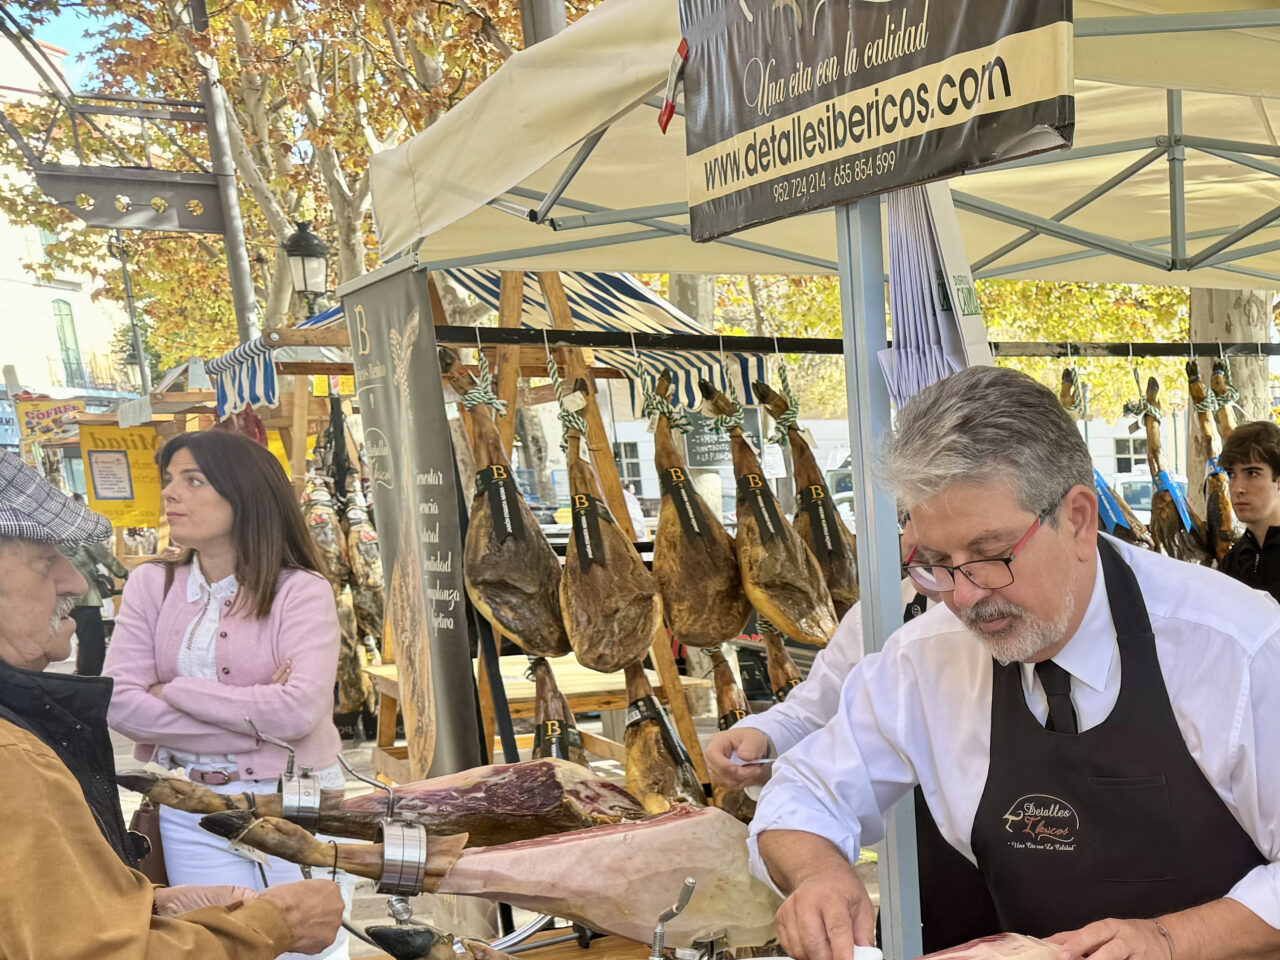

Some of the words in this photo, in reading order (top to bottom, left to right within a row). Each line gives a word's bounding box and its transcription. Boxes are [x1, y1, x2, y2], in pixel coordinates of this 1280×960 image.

[743, 57, 787, 116] Una
[789, 61, 813, 98] cita
[816, 55, 840, 87] con
[843, 30, 859, 77] la
[863, 0, 930, 69] calidad
[703, 54, 1012, 192] www.detallesibericos.com
[772, 183, 790, 203] 952
[790, 178, 807, 198] 724
[807, 174, 826, 194] 214
[833, 164, 852, 187] 655
[854, 158, 874, 180] 854
[876, 150, 896, 174] 599
[490, 465, 508, 479] B
[668, 468, 685, 481] B
[747, 474, 763, 488] B
[809, 485, 825, 499] B
[574, 494, 589, 508] B
[545, 720, 561, 735] B
[1023, 802, 1072, 818] Detalles
